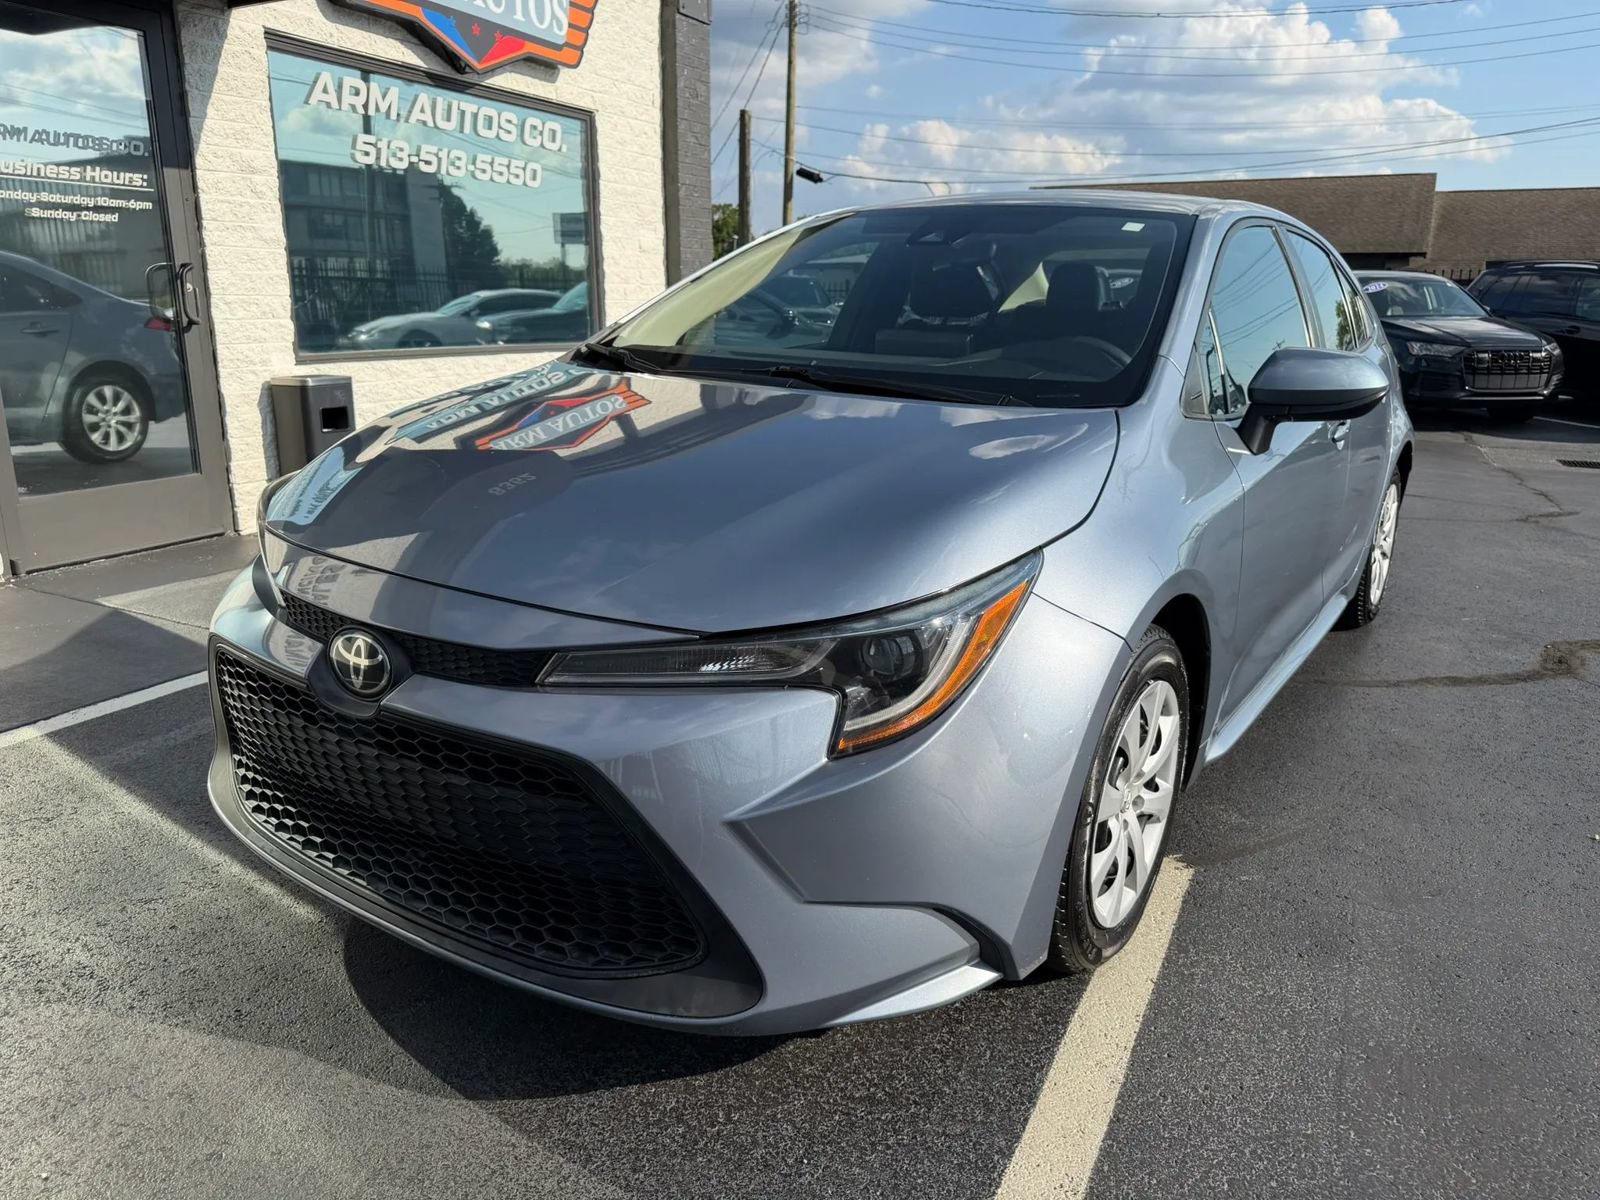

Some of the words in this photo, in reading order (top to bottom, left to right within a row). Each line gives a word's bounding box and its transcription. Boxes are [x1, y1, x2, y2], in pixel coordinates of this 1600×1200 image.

[464, 0, 568, 36] TOS
[308, 71, 399, 120] ARM
[408, 92, 518, 143] AUTOS
[523, 117, 567, 152] CO.
[85, 165, 148, 187] Hours:
[354, 133, 542, 188] 513-513-5550
[31, 207, 77, 222] Sunday
[81, 211, 119, 223] Closed
